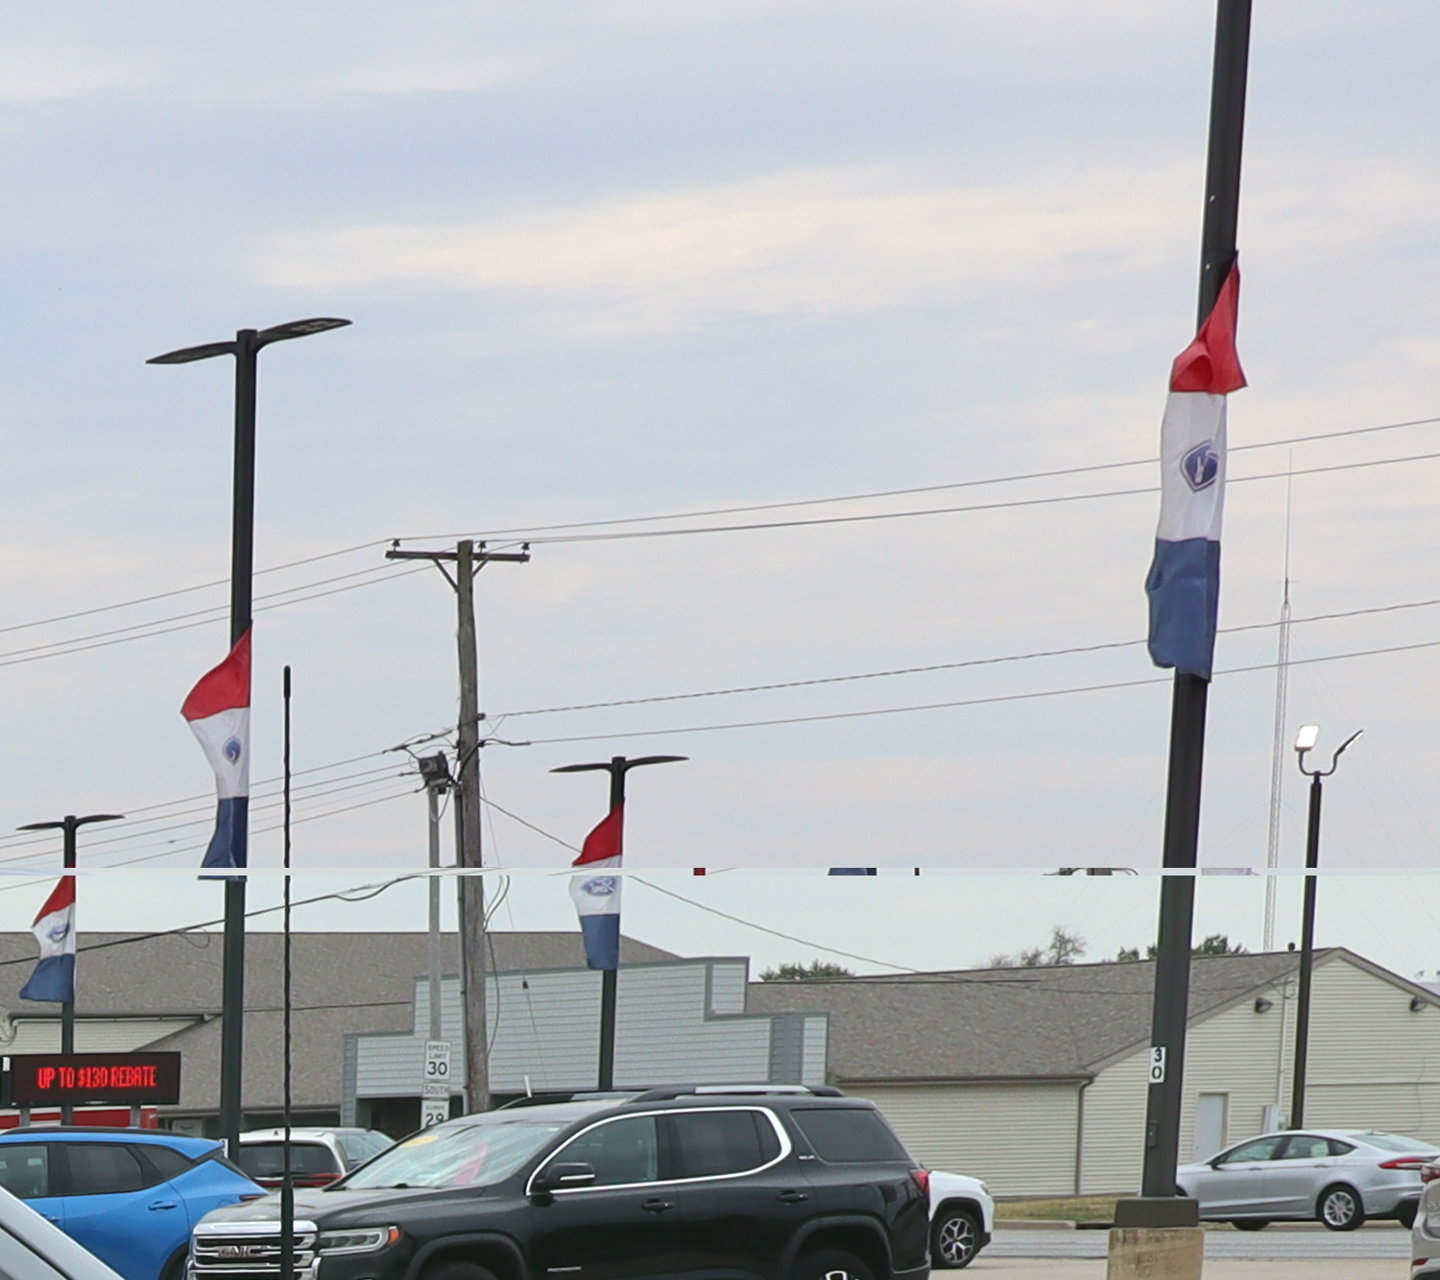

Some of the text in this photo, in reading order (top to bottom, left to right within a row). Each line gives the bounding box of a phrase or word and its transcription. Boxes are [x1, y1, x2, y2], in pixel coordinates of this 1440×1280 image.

[428, 1044, 450, 1052] SPEED
[426, 1061, 448, 1076] 30
[37, 1066, 56, 1089] UP
[58, 1066, 75, 1089] TO
[110, 1065, 158, 1088] REBATE
[424, 1085, 449, 1096] SOUTH
